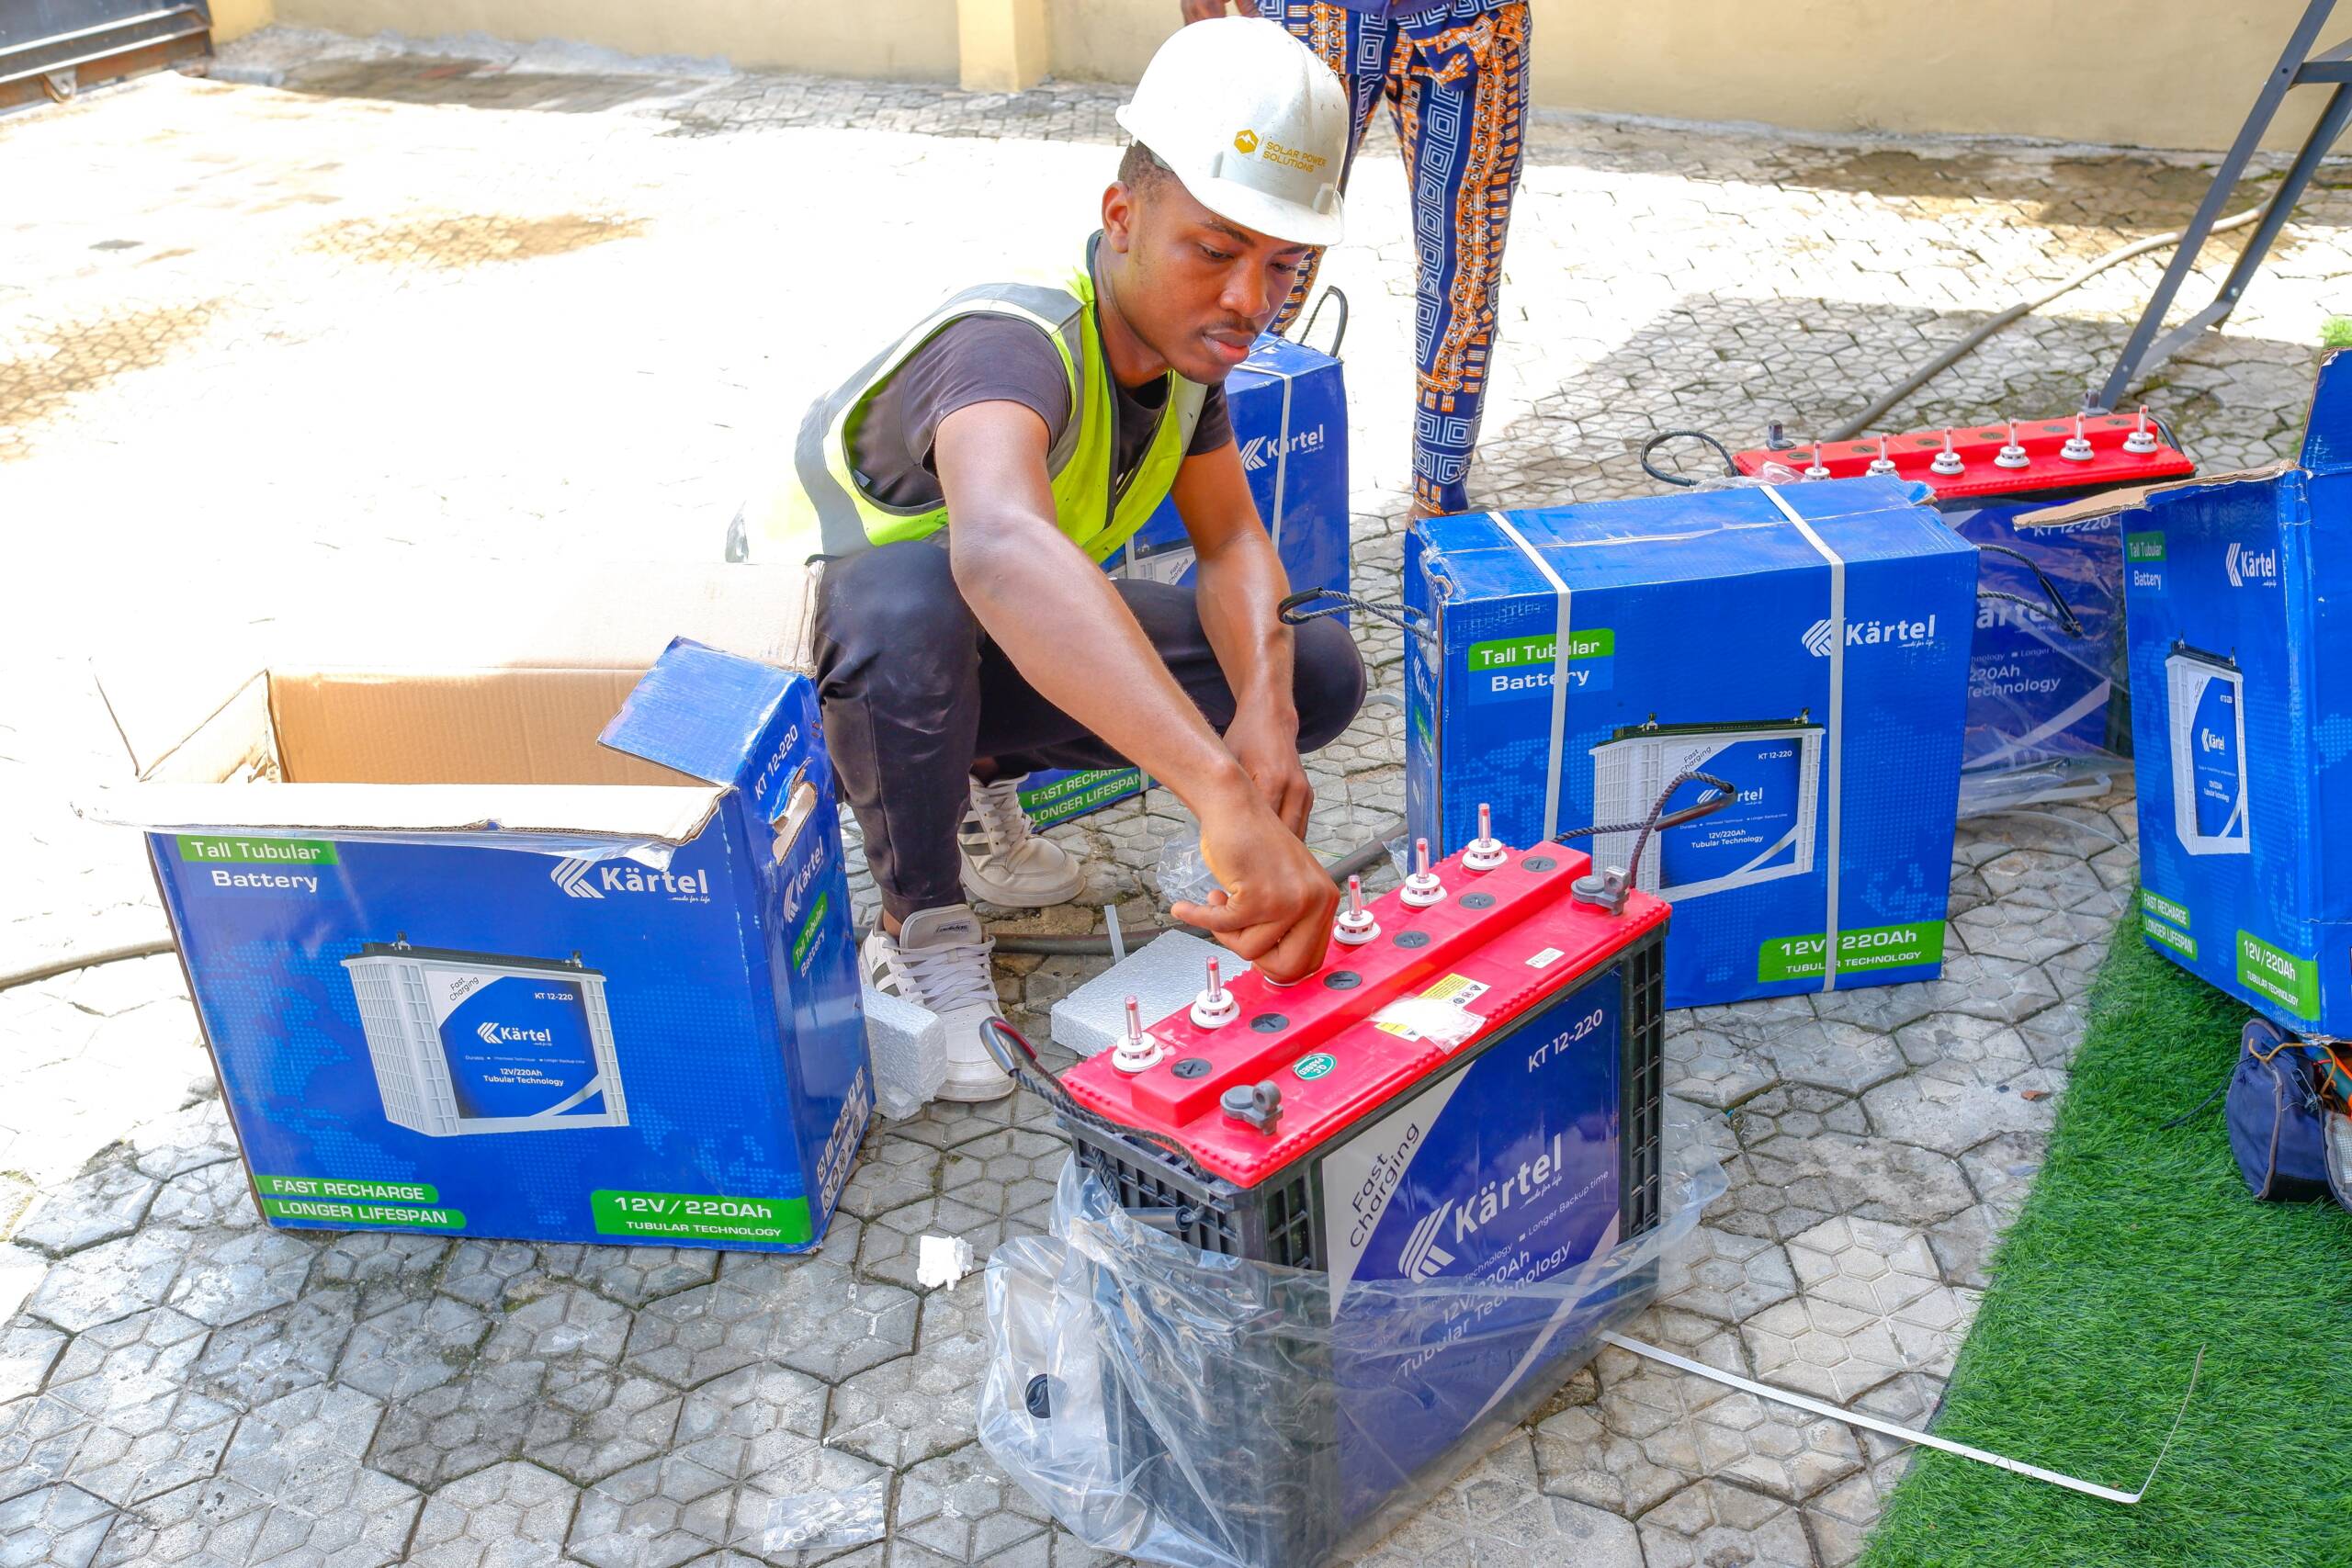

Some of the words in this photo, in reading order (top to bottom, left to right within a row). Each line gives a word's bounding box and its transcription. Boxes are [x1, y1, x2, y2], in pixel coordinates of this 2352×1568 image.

[1263, 151, 1314, 173] SOLUTIONS
[1266, 141, 1300, 158] SOLAR
[1302, 152, 1328, 166] POWER
[2130, 542, 2140, 558] Tall
[2141, 541, 2163, 558] Tubular
[2241, 548, 2277, 577] Kärtel
[2133, 570, 2161, 590] Battery
[1845, 615, 1936, 646] Kärtel
[1481, 648, 1516, 665] Tall
[1523, 640, 1600, 660] Tublar
[1971, 651, 2006, 662] hnology
[1970, 664, 2020, 682] 220Ah
[755, 772, 768, 801] KT
[767, 724, 798, 777] 12-220
[1683, 749, 1699, 762] Fast
[1770, 750, 1792, 759] 12-220
[1031, 784, 1064, 805] FAST
[1736, 786, 1763, 802] rtel
[1032, 796, 1083, 822] LONGER
[1691, 840, 1719, 849] Tubular
[1722, 835, 1764, 845] Technology
[1709, 829, 1747, 839] 12V/220Ah
[191, 841, 231, 858] Tall
[236, 842, 321, 860] Tubular
[797, 835, 824, 893] Kärtel
[211, 870, 318, 893] Battery
[601, 867, 708, 894] Kärtel
[2144, 893, 2156, 911] FAST
[2158, 898, 2187, 925] RECHARGE
[1781, 930, 1917, 955] 12V220Ah
[2145, 918, 2166, 940] LONGER
[2167, 928, 2193, 954] LIFESPAN
[800, 928, 826, 978] Battery
[1786, 960, 1841, 973] TUBULR
[1845, 952, 1921, 966] TECHNOLOGY
[2244, 940, 2296, 982] 12V/220Ah
[450, 976, 465, 991] Fast
[450, 976, 479, 1000] Charging
[2246, 970, 2267, 989] TUBULAR
[2268, 982, 2298, 1007] TECHNOLOGY
[535, 992, 545, 1000] KT
[548, 992, 573, 1000] 12-220
[501, 1027, 551, 1042] Kärtel
[1529, 1043, 1549, 1073] KT
[1553, 1009, 1602, 1055] 12-220
[483, 1075, 514, 1083] Tubular
[516, 1077, 564, 1087] Technology
[500, 1067, 543, 1077] 12V/220Ah
[272, 1179, 318, 1194] FAST
[323, 1182, 425, 1201] RECHARGE
[1350, 1122, 1419, 1248] Charging
[1352, 1153, 1388, 1213] Fast
[1455, 1132, 1561, 1244] Kärtel
[278, 1201, 354, 1219] LONGER
[358, 1206, 447, 1224] LIFESPAN
[1529, 1209, 1557, 1235] Longer
[1559, 1186, 1589, 1213] Backup
[1590, 1170, 1609, 1189] time
[626, 1221, 689, 1232] TUBULAR
[694, 1224, 782, 1236] TECHNOLOGY
